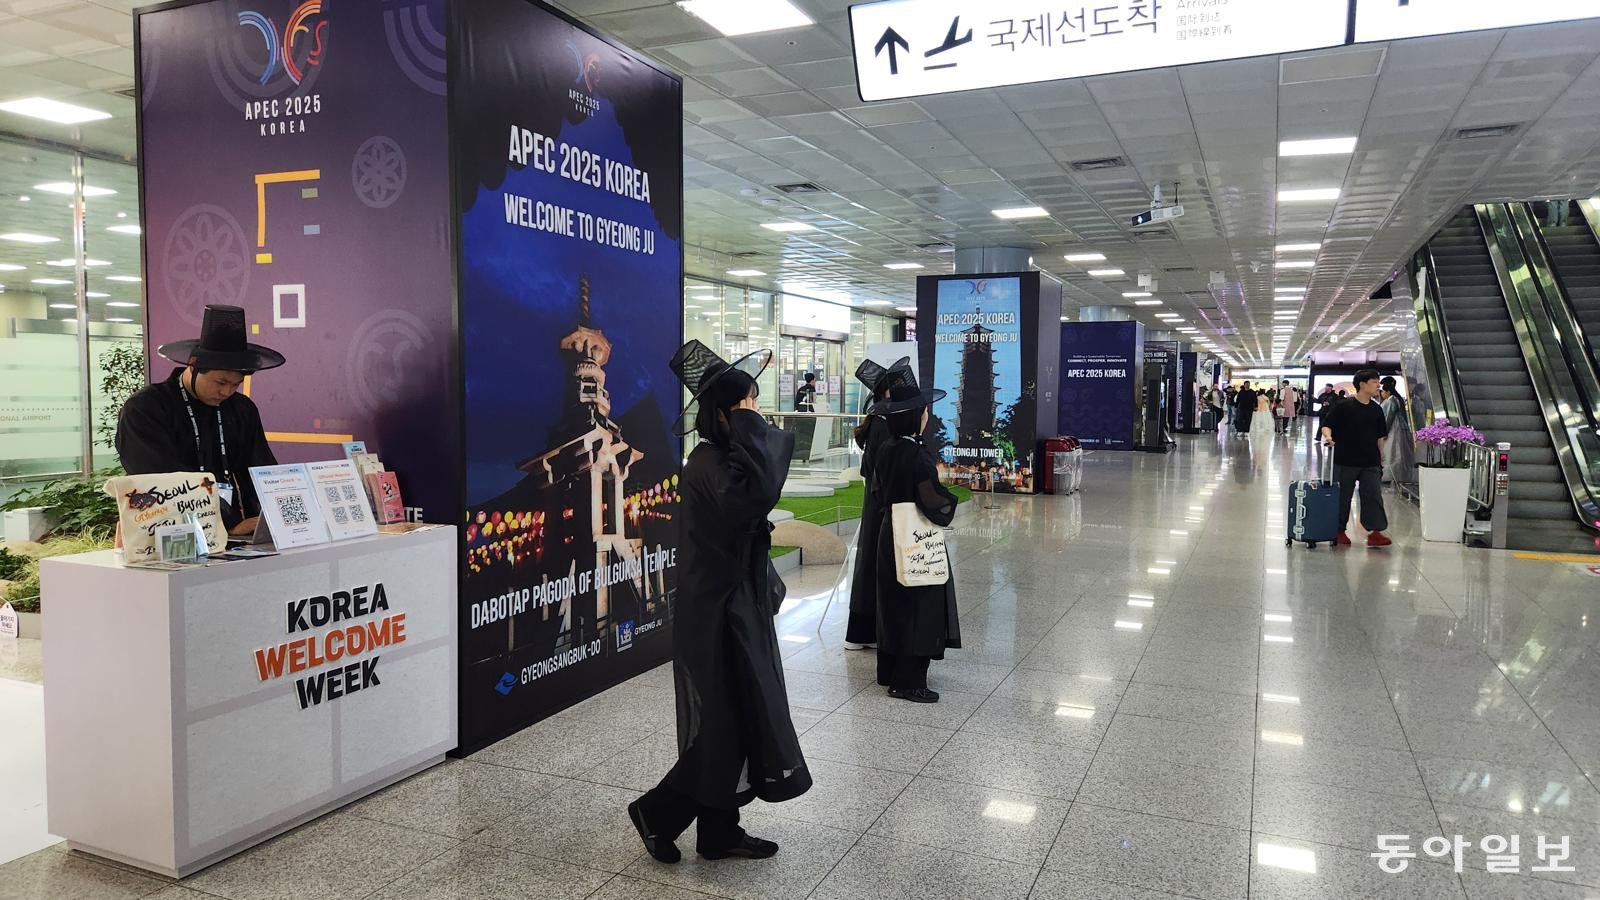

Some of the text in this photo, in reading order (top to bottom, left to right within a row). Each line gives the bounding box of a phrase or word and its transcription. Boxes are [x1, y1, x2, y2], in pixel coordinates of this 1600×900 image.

[987, 0, 1162, 51] 국제선도착
[245, 94, 321, 120] APEC 2025
[568, 88, 600, 110] APEC 2025
[260, 120, 305, 136] KOREA
[508, 124, 650, 204] APEC 2025 KOREA
[504, 192, 655, 255] WELCOME TO GYEONG JU
[938, 312, 1015, 324] APEC 2025 KOREA
[935, 332, 1018, 343] WELCOME TO GYEONG JU
[1068, 369, 1126, 378] APEC 2025 KOREA
[944, 447, 1004, 458] GYEONGJU TOWER
[148, 480, 200, 505] SEOUL
[177, 495, 211, 514] BUSAN
[471, 548, 677, 630] DABOTAP PAGODA OF BULGUKSA TEMPLE
[287, 583, 390, 634] KOREA
[634, 619, 663, 636] GYEONG JU
[255, 613, 407, 681] WELCOME
[521, 638, 601, 685] GYEONGSANGBUK-DO
[296, 656, 381, 710] WEEK
